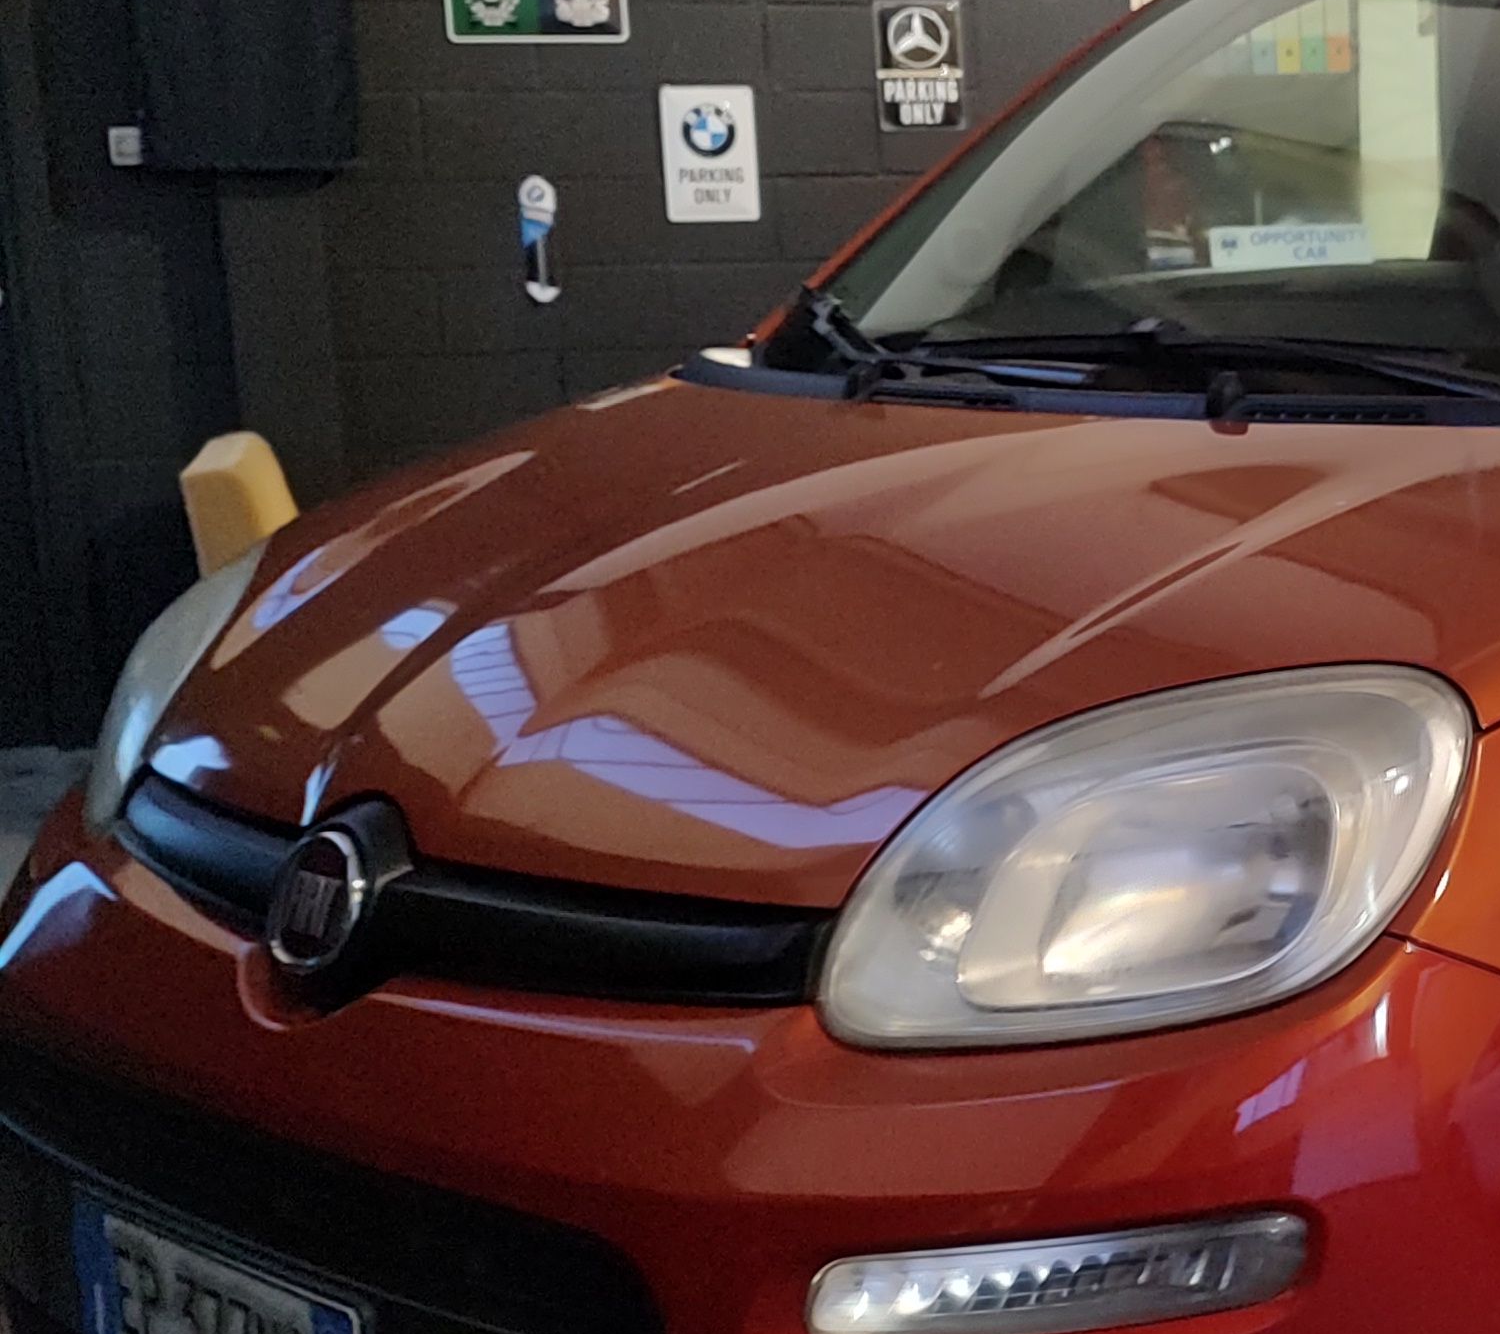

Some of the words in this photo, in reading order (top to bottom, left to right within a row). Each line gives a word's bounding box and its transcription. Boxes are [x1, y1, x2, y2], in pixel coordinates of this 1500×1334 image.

[883, 79, 959, 103] PARKING
[899, 101, 945, 125] ONLY
[678, 167, 745, 184] PARKING
[693, 187, 732, 205] ONLY
[1250, 228, 1367, 247] OPPORTUNITY
[1293, 245, 1328, 261] CAR
